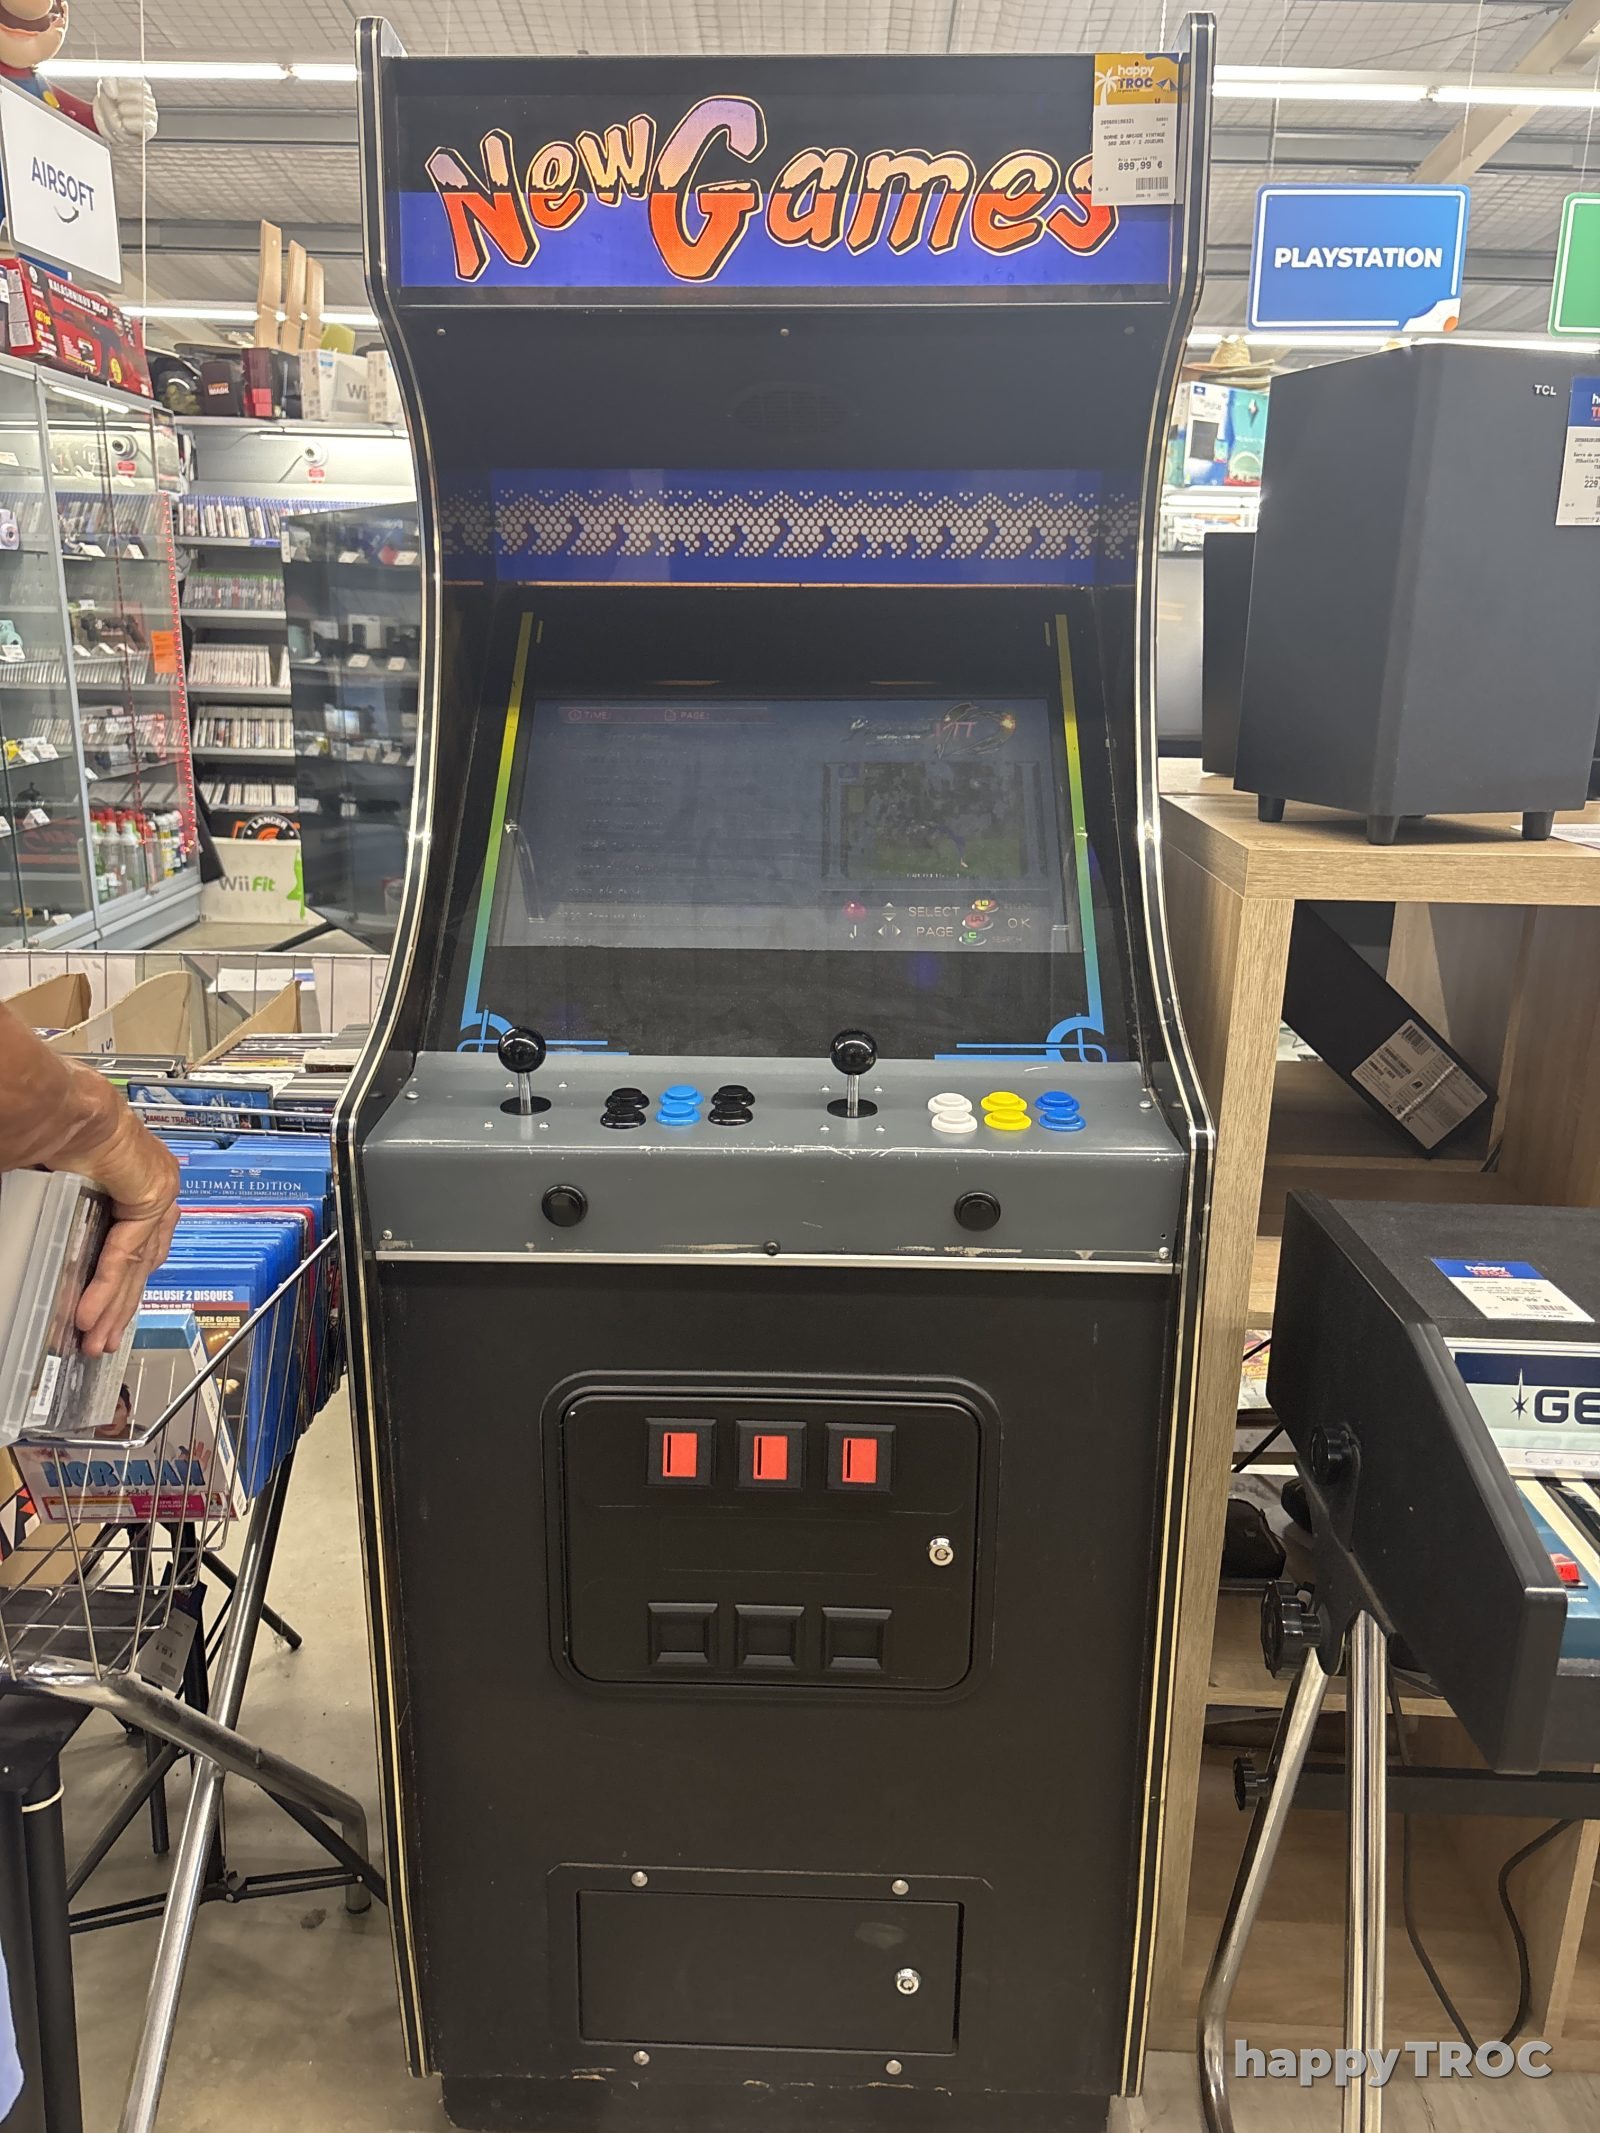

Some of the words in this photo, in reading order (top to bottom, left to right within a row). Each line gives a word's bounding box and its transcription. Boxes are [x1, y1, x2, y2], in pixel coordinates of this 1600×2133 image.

[1117, 64, 1155, 77] happy
[1118, 78, 1153, 89] TROC
[1118, 161, 1152, 172] 899,99
[31, 156, 94, 212] AIRSOFT
[424, 113, 656, 282] New
[1274, 247, 1443, 268] PLAYSTATION
[346, 382, 367, 401] Wi
[1534, 384, 1557, 396] TCL
[252, 876, 276, 892] Fit
[908, 906, 961, 917] SELECT
[1007, 917, 1032, 929] OK
[916, 926, 954, 937] PAGE
[186, 1180, 245, 1190] ULTIMATE
[249, 1182, 302, 1191] EDITION
[143, 1290, 184, 1301] EXCLUSIF
[186, 1290, 193, 1301] 2
[194, 1290, 234, 1302] DISQUES
[41, 1459, 206, 1487] NORMAN
